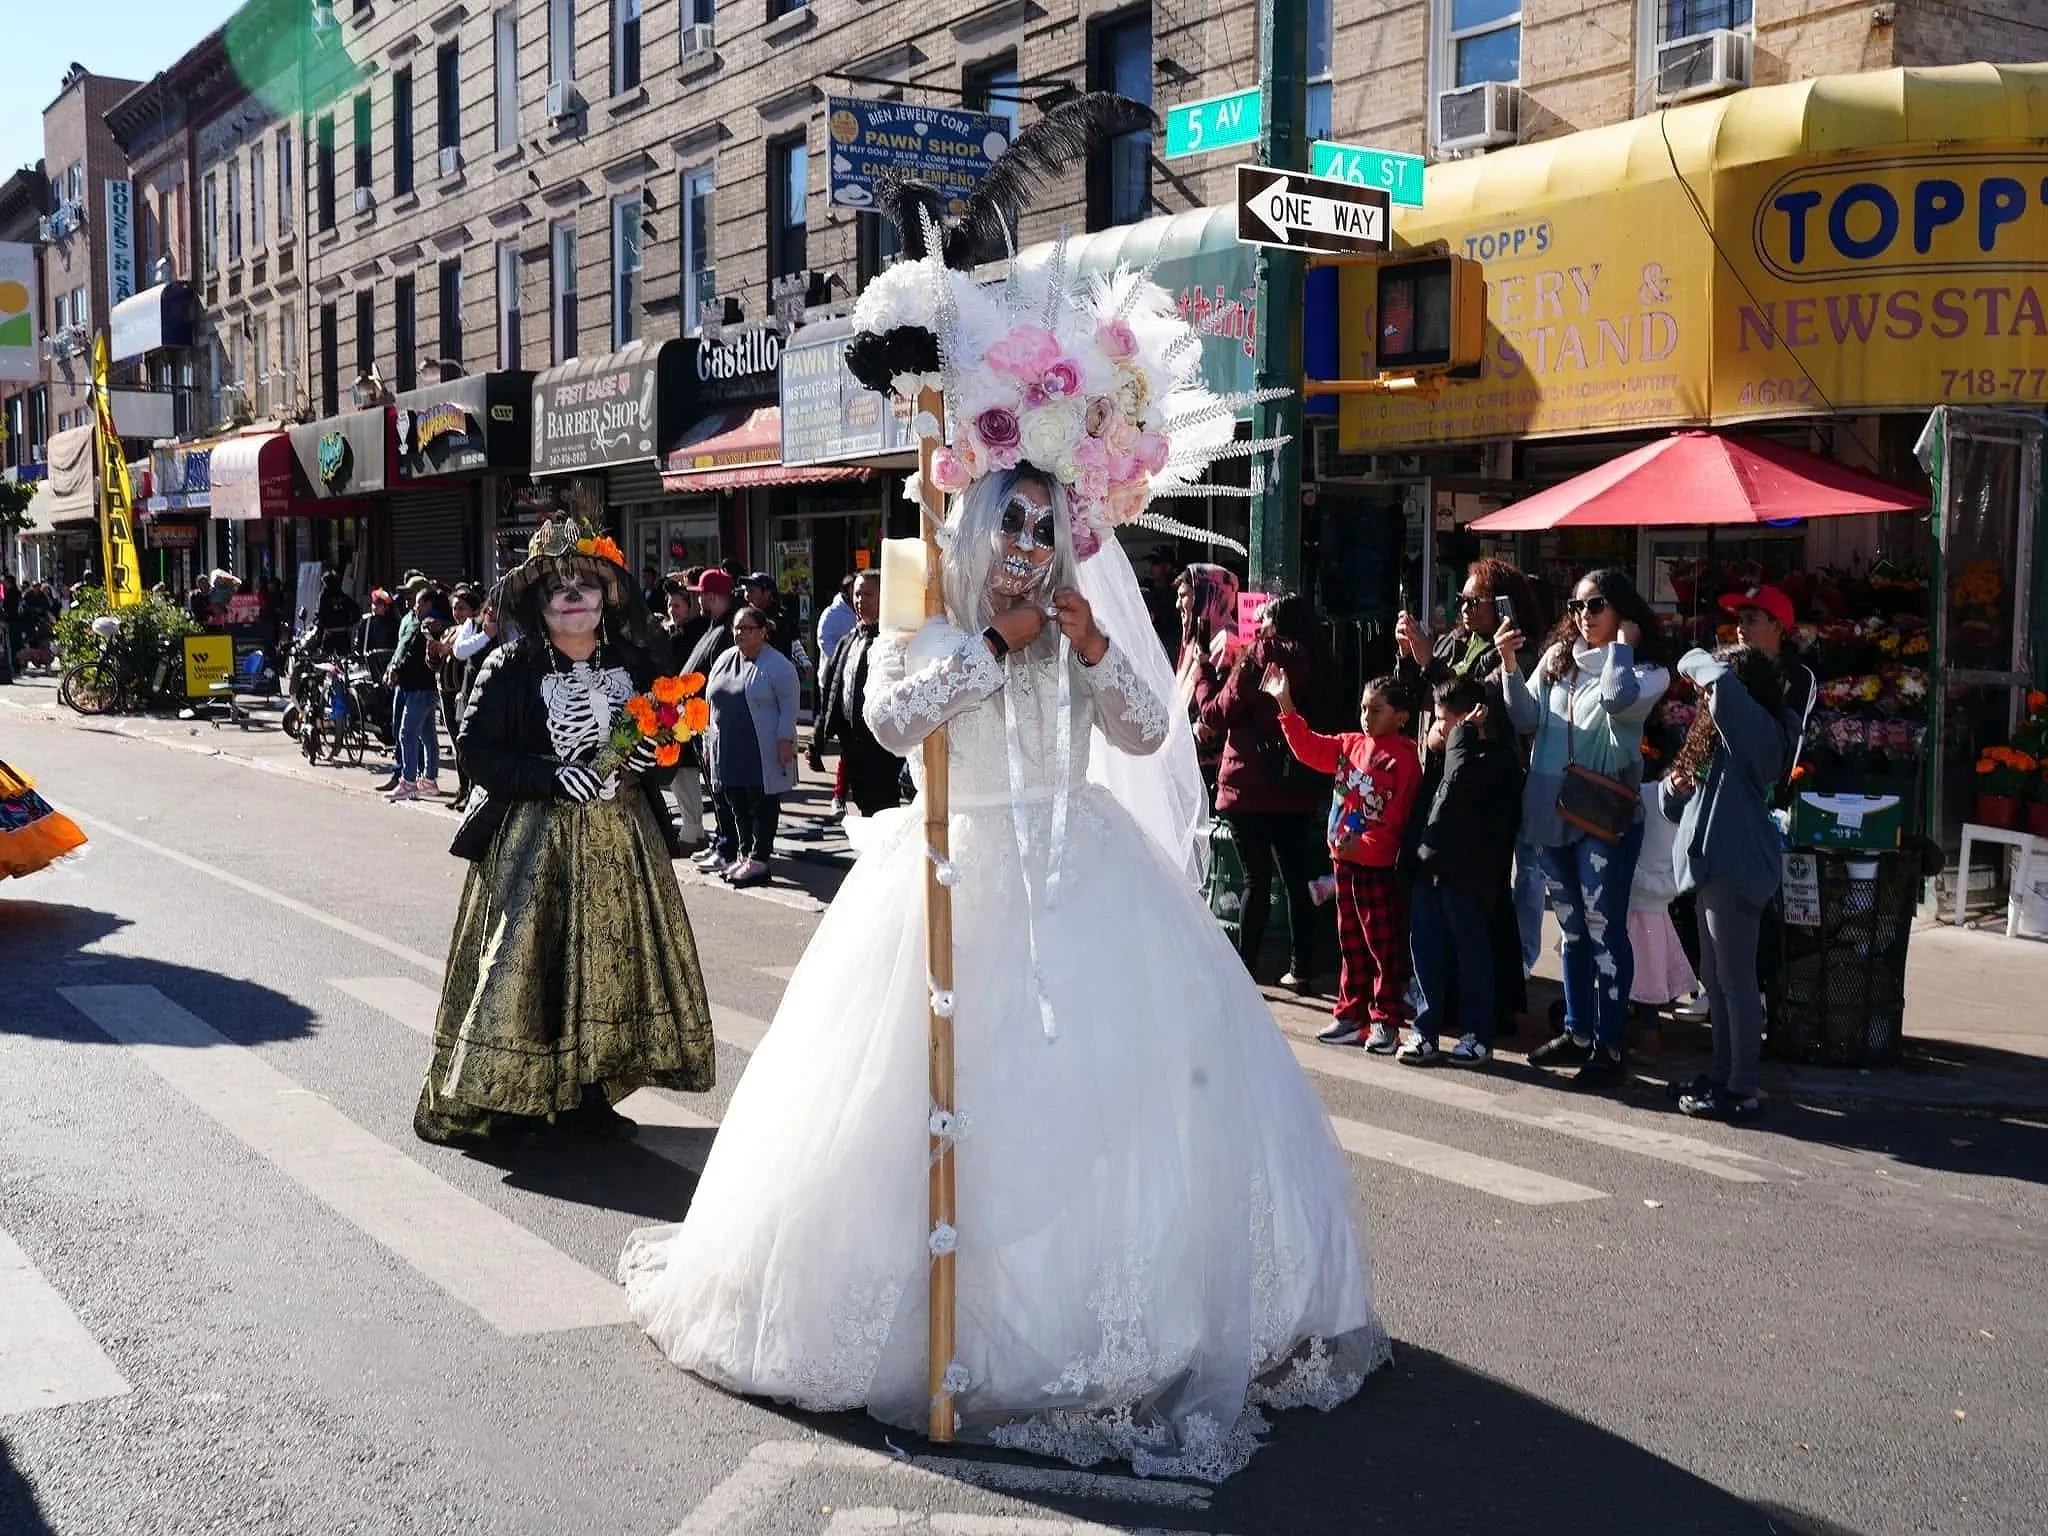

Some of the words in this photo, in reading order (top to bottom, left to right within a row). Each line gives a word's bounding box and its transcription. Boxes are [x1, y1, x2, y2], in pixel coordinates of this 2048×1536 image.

[895, 107, 939, 124] JEWELRY
[1187, 109, 1204, 149] 5
[1215, 101, 1244, 132] AV
[865, 131, 922, 151] PAWN
[928, 139, 981, 158] SHOP
[866, 148, 889, 158] GOLD
[861, 162, 888, 178] CAS
[1324, 151, 1365, 184] 46
[1380, 158, 1408, 188] ST
[112, 181, 128, 249] HOUSES
[1270, 196, 1312, 226] ONE
[1334, 204, 1375, 236] WAY
[1466, 223, 1549, 261] TOPP'S
[1638, 261, 1673, 307] &
[1738, 286, 2048, 352] NEWSSTA
[696, 328, 779, 381] Castillo
[784, 344, 829, 378] PAWN
[555, 384, 586, 407] FIRST
[586, 375, 617, 401] BASE
[1739, 377, 1814, 407] 4602
[547, 408, 600, 439] BARBER
[603, 400, 639, 430] SHOP
